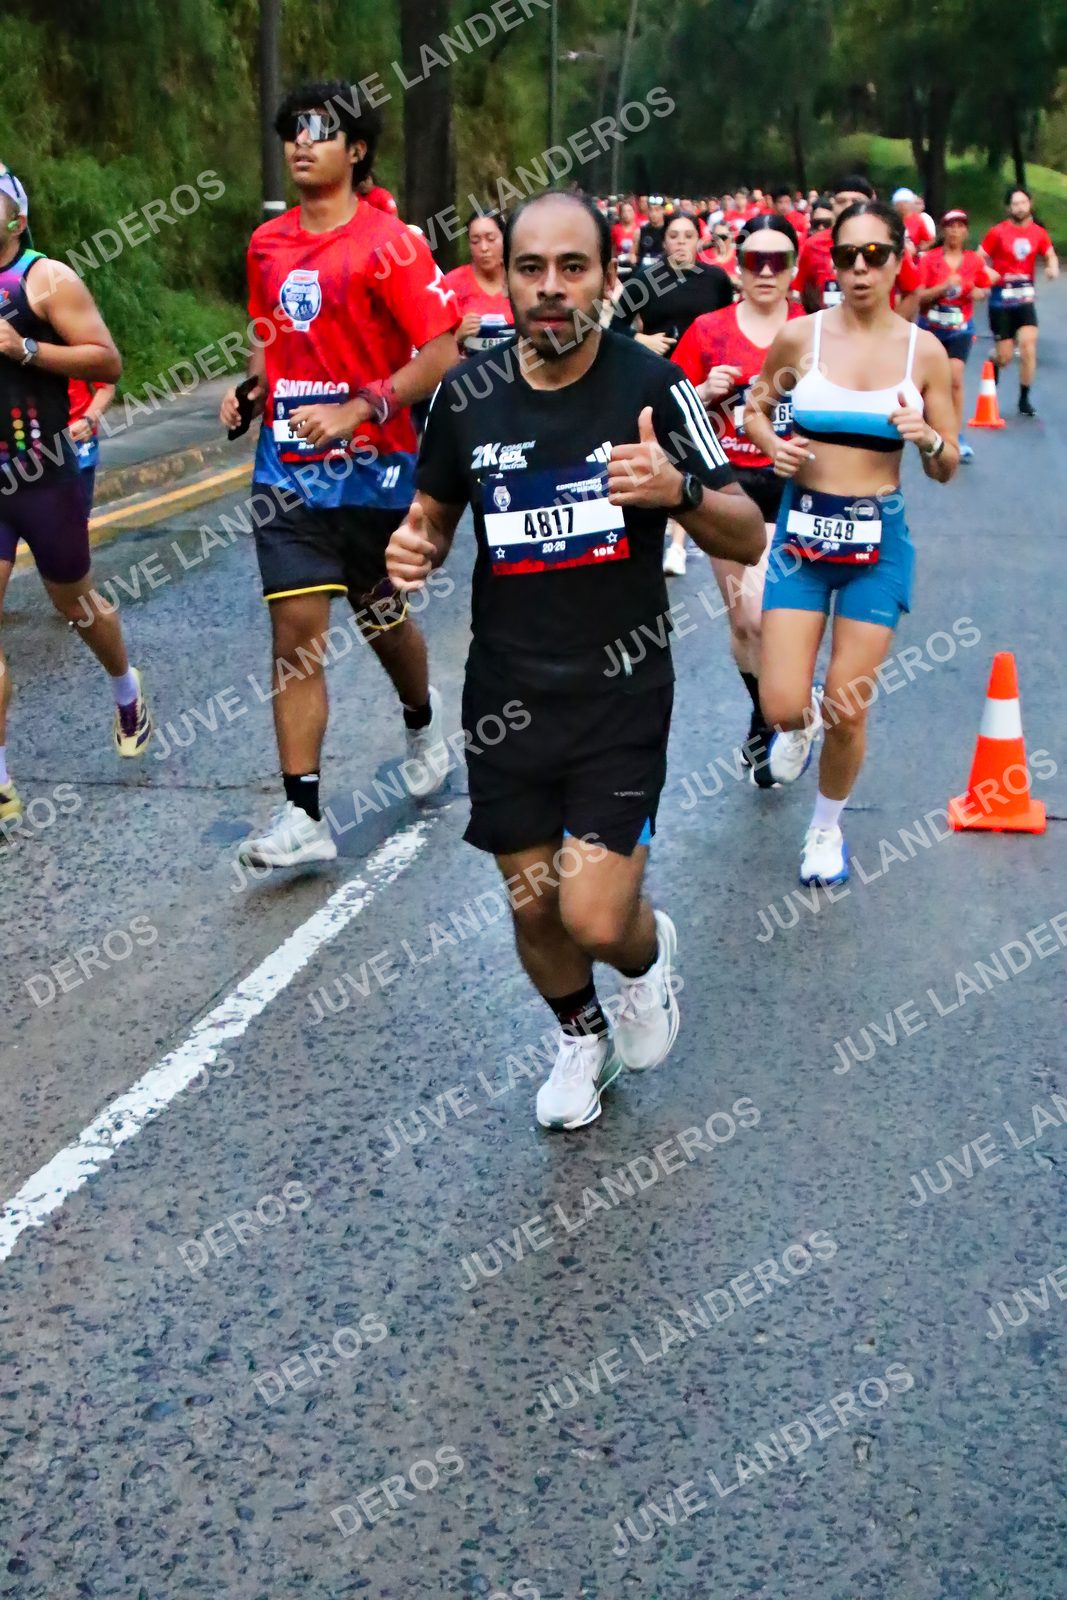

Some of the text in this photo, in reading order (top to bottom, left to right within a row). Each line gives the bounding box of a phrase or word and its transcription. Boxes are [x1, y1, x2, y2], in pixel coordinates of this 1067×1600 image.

[471, 443, 501, 469] 2K
[524, 507, 574, 538] 4817
[813, 518, 855, 540] 5548
[542, 541, 566, 553] 20-26
[593, 546, 615, 557] 10K
